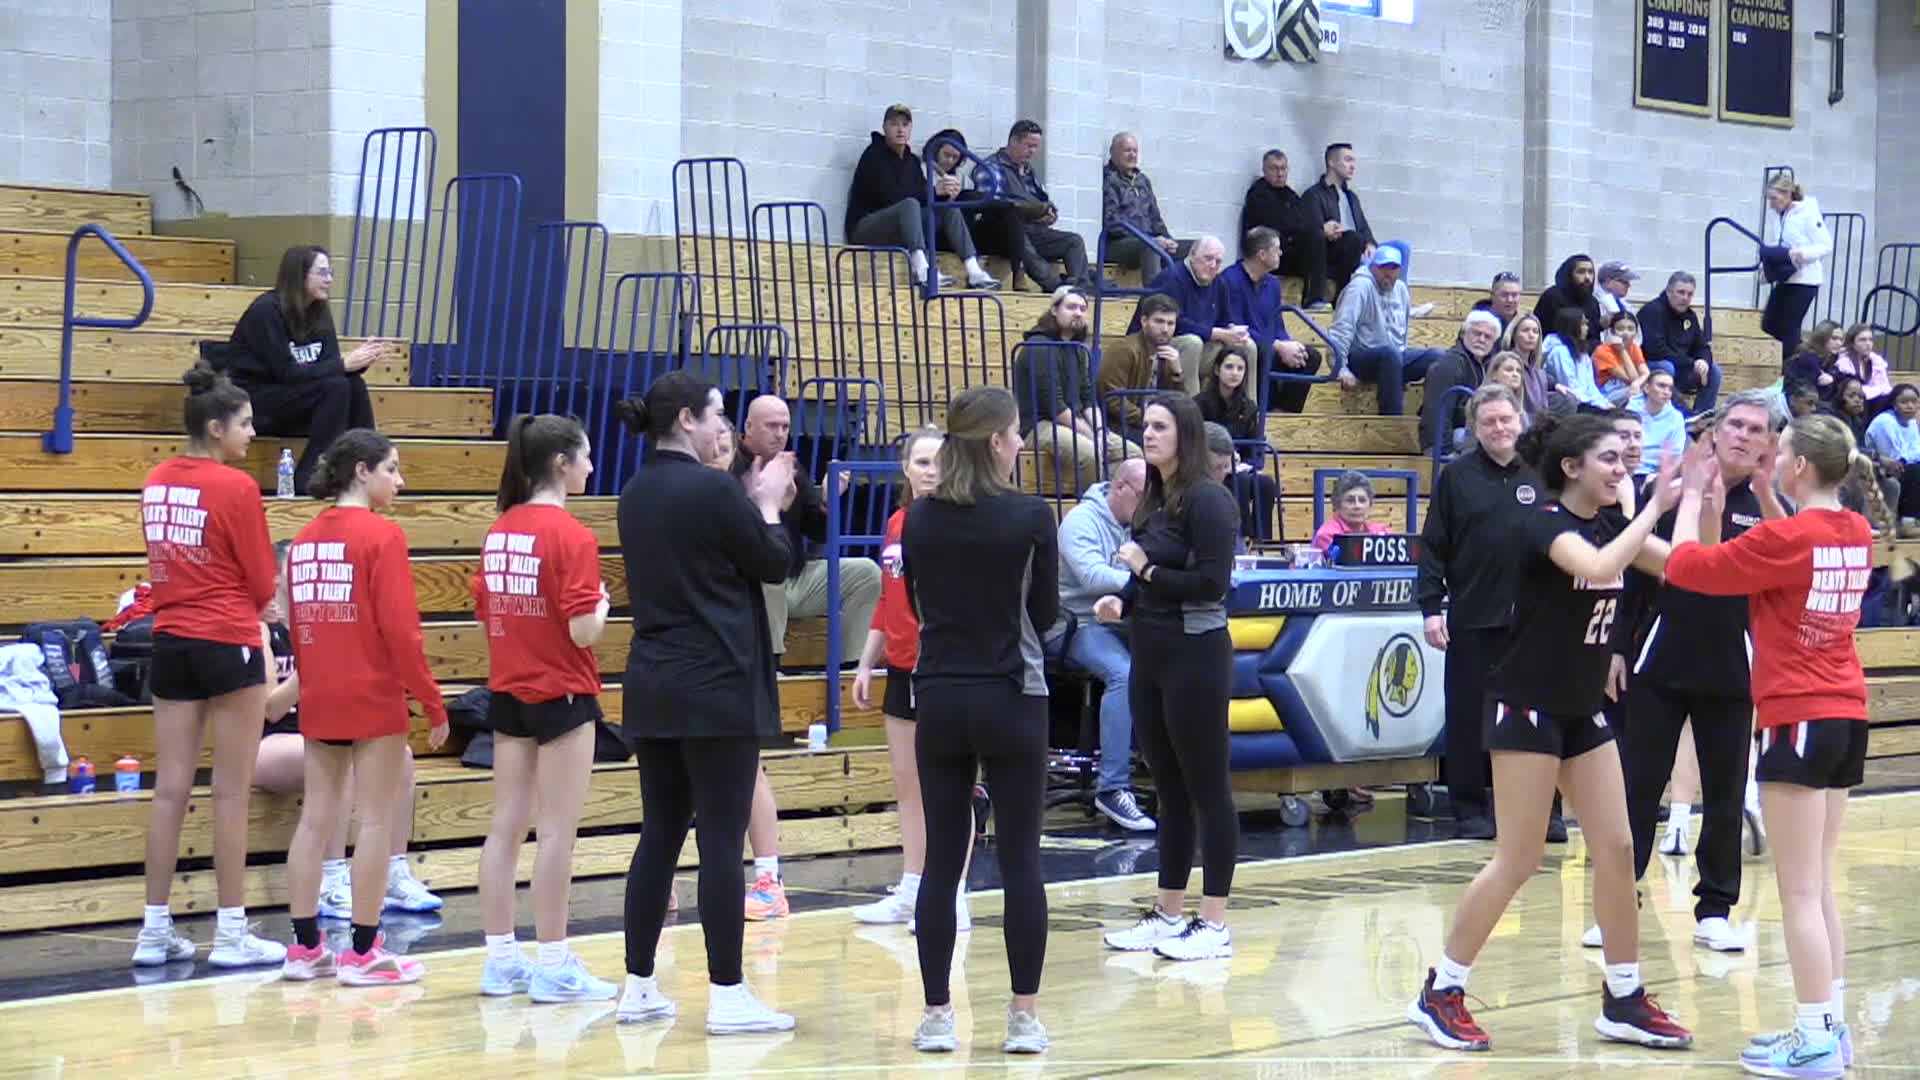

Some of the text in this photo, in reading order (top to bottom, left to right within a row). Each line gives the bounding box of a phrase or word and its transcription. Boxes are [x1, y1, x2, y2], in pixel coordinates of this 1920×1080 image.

[1731, 7, 1790, 30] CHAMPIONS
[170, 506, 208, 528] TALENT
[167, 525, 203, 547] TALENT
[1362, 537, 1410, 563] POSS.
[320, 562, 353, 582] TALENT
[509, 553, 541, 577] TALENT
[317, 582, 352, 603] TALENT
[506, 574, 538, 597] TALENT
[1259, 578, 1412, 610] HOME OF THE
[1584, 598, 1617, 645] 22
